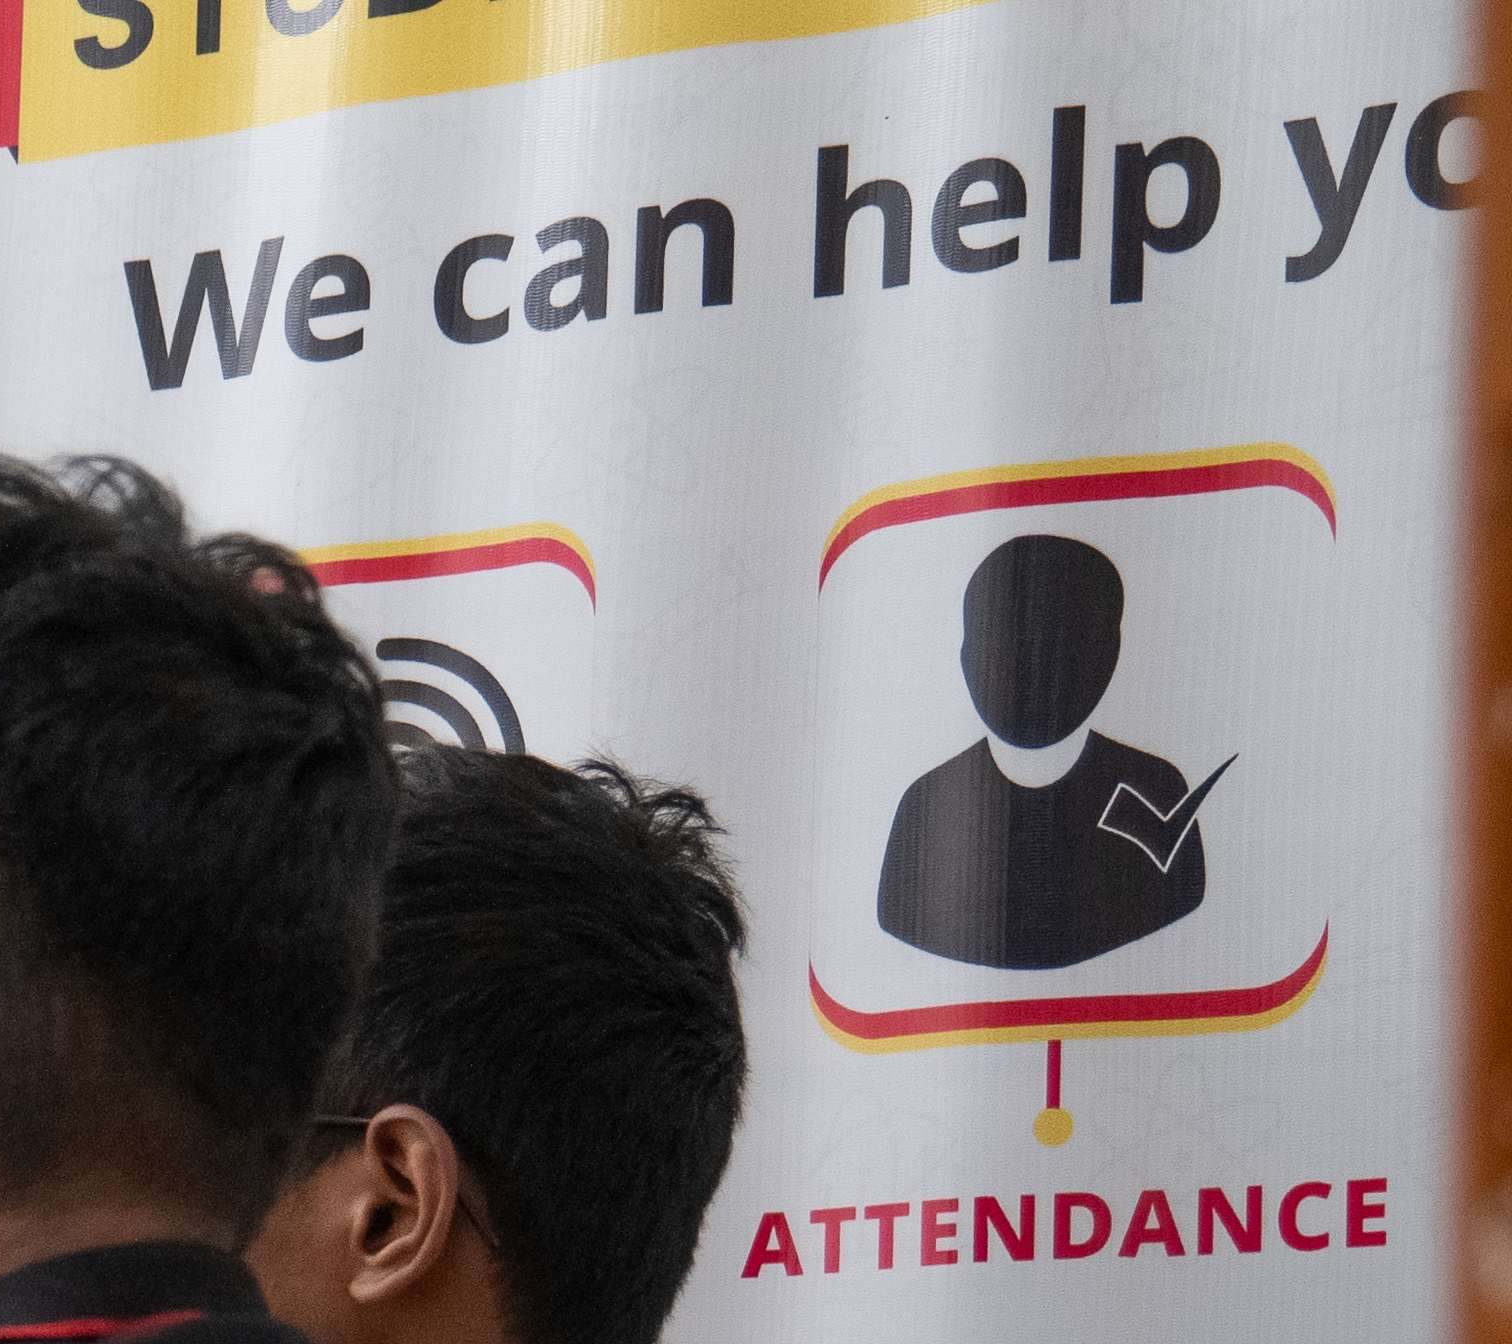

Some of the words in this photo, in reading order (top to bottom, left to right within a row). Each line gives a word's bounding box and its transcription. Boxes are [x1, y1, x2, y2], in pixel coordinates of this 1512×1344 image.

[124, 237, 370, 391] We
[433, 195, 737, 346] can
[814, 105, 1221, 304] help
[741, 1178, 1387, 1278] ATTENDANCE
